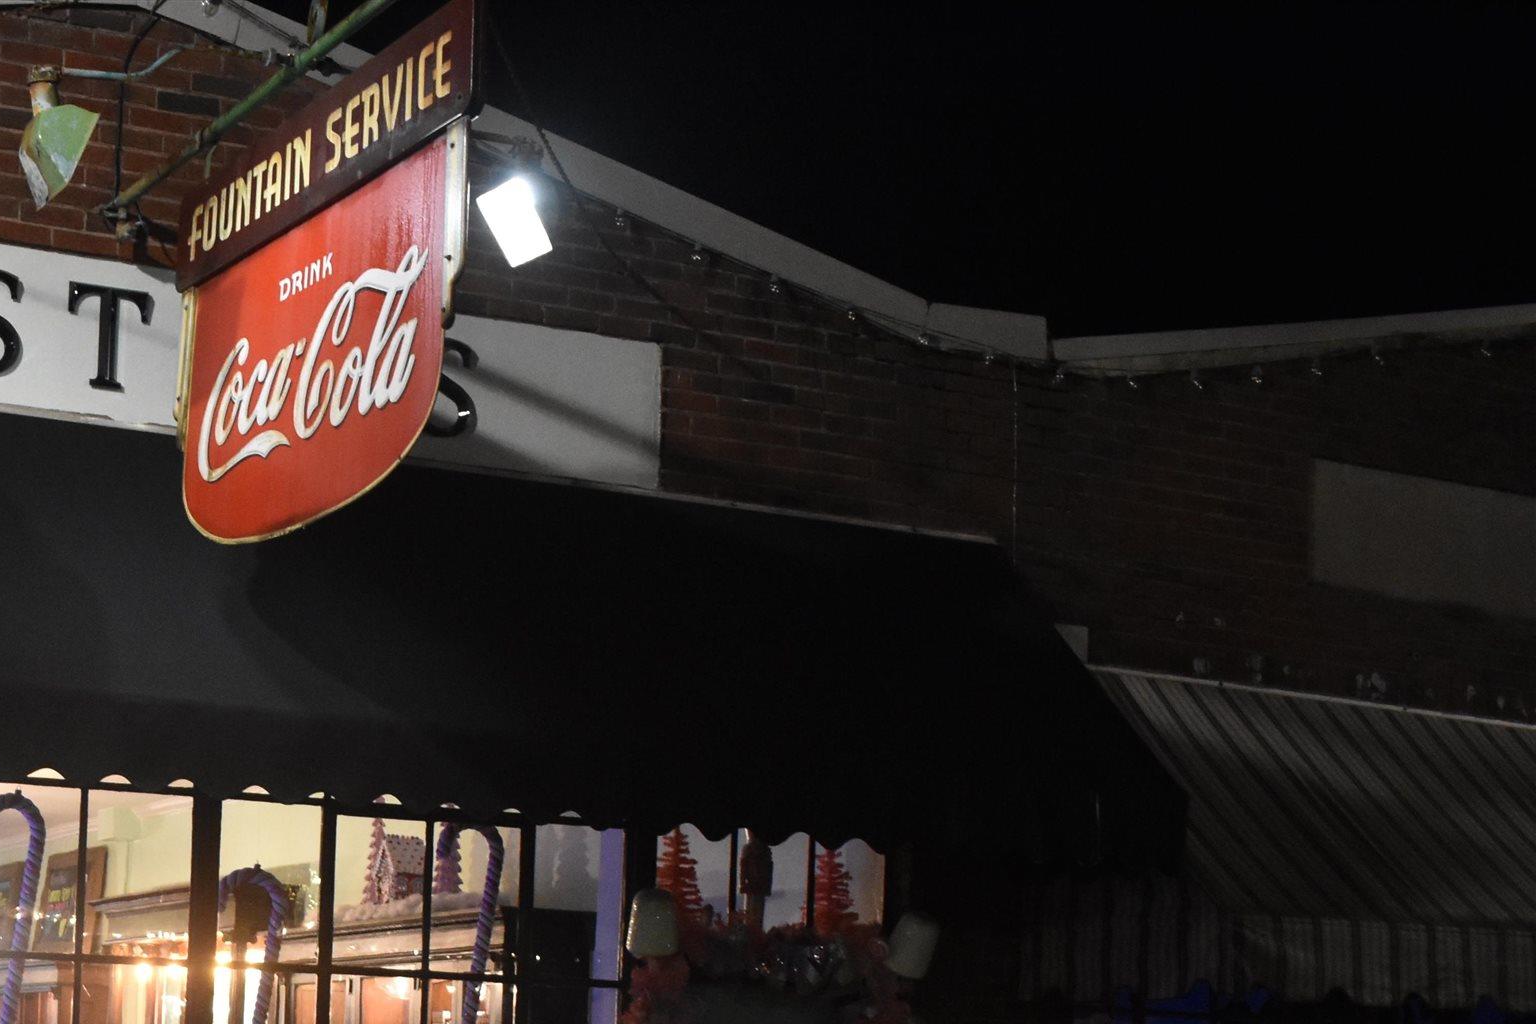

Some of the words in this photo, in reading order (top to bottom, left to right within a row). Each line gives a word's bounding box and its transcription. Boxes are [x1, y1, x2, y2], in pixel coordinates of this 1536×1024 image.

[187, 128, 313, 263] FOUNTAIN
[324, 29, 453, 174] SERVICE
[197, 245, 429, 482] Coca-Cola
[278, 252, 334, 302] DRINK
